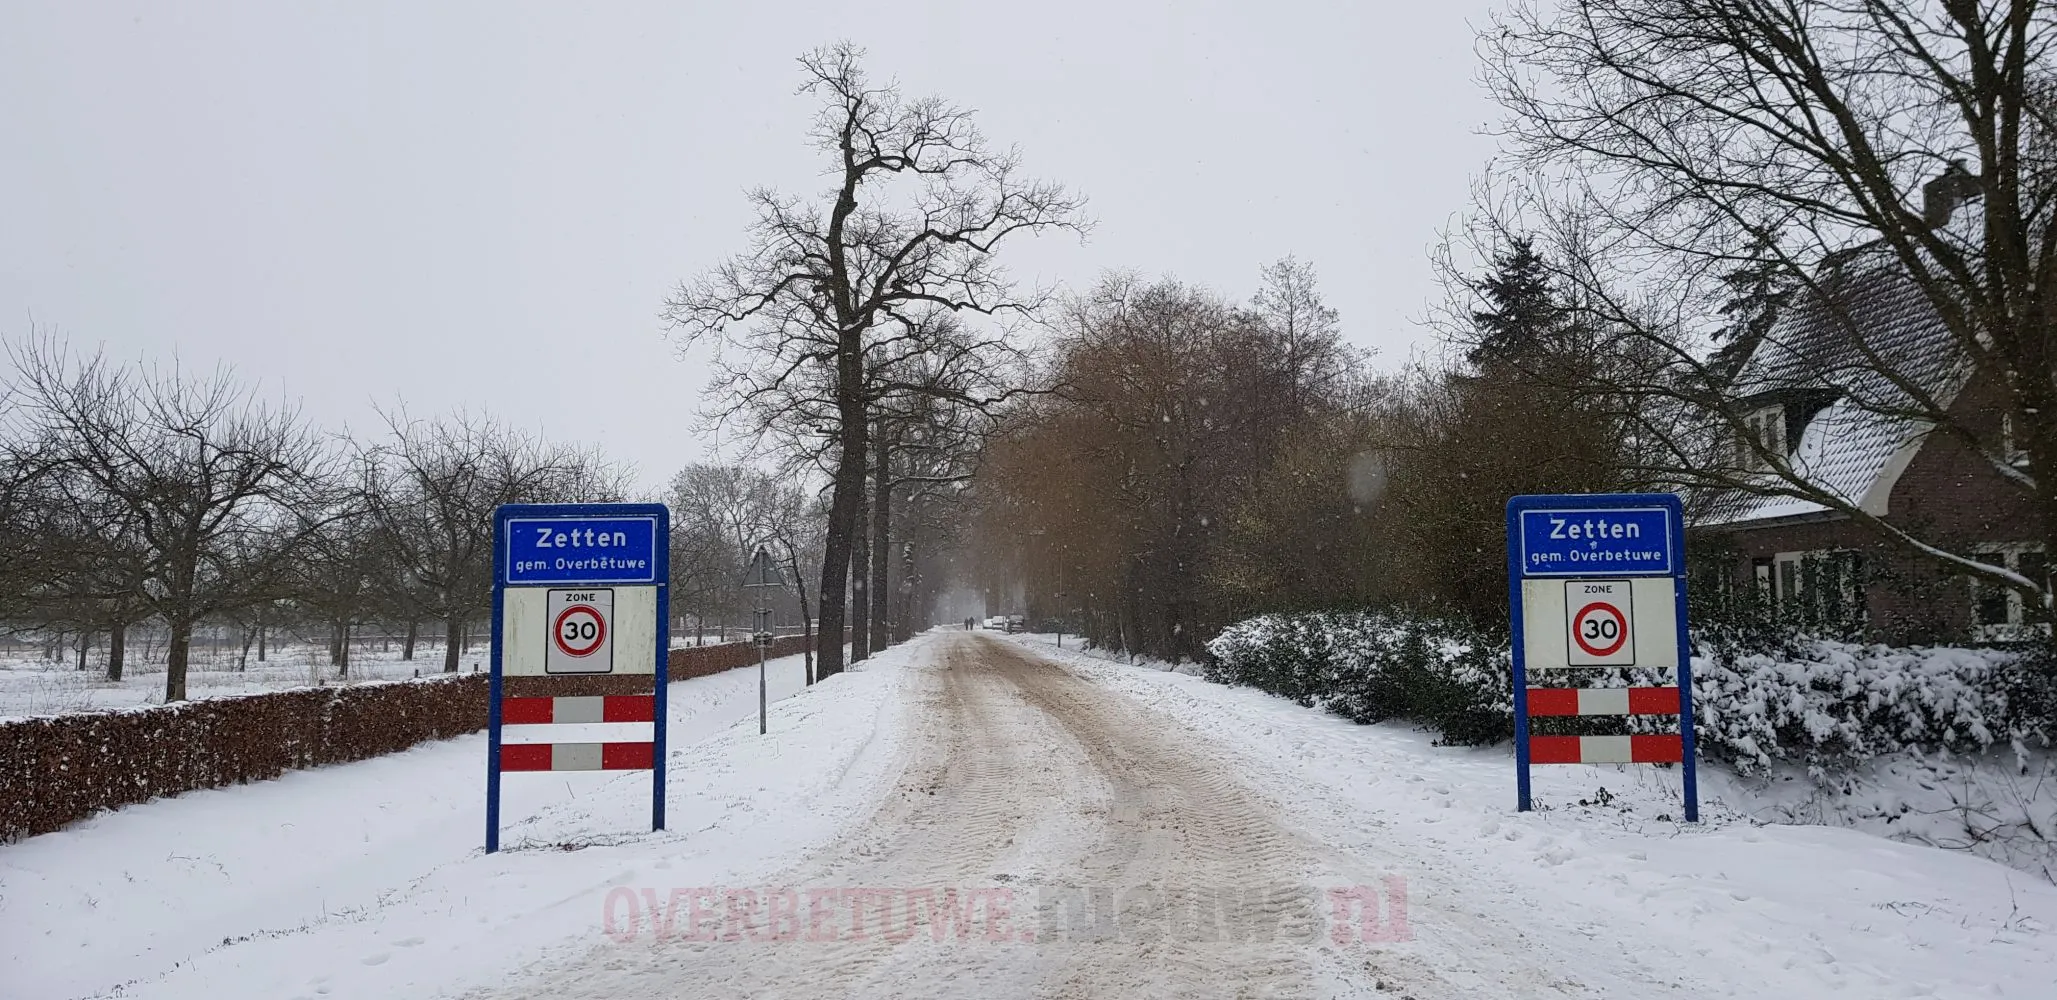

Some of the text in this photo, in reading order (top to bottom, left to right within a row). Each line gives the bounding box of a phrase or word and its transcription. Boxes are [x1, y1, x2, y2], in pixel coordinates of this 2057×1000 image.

[1550, 519, 1640, 539] Zetten
[536, 528, 626, 548] Zetten
[516, 558, 646, 573] gem. Overbetuwe
[1531, 549, 1662, 565] gem. Overbetuwe
[566, 593, 596, 602] ZONE
[1584, 585, 1613, 594] ZONE
[564, 622, 596, 640] 30
[1584, 619, 1618, 639] 30
